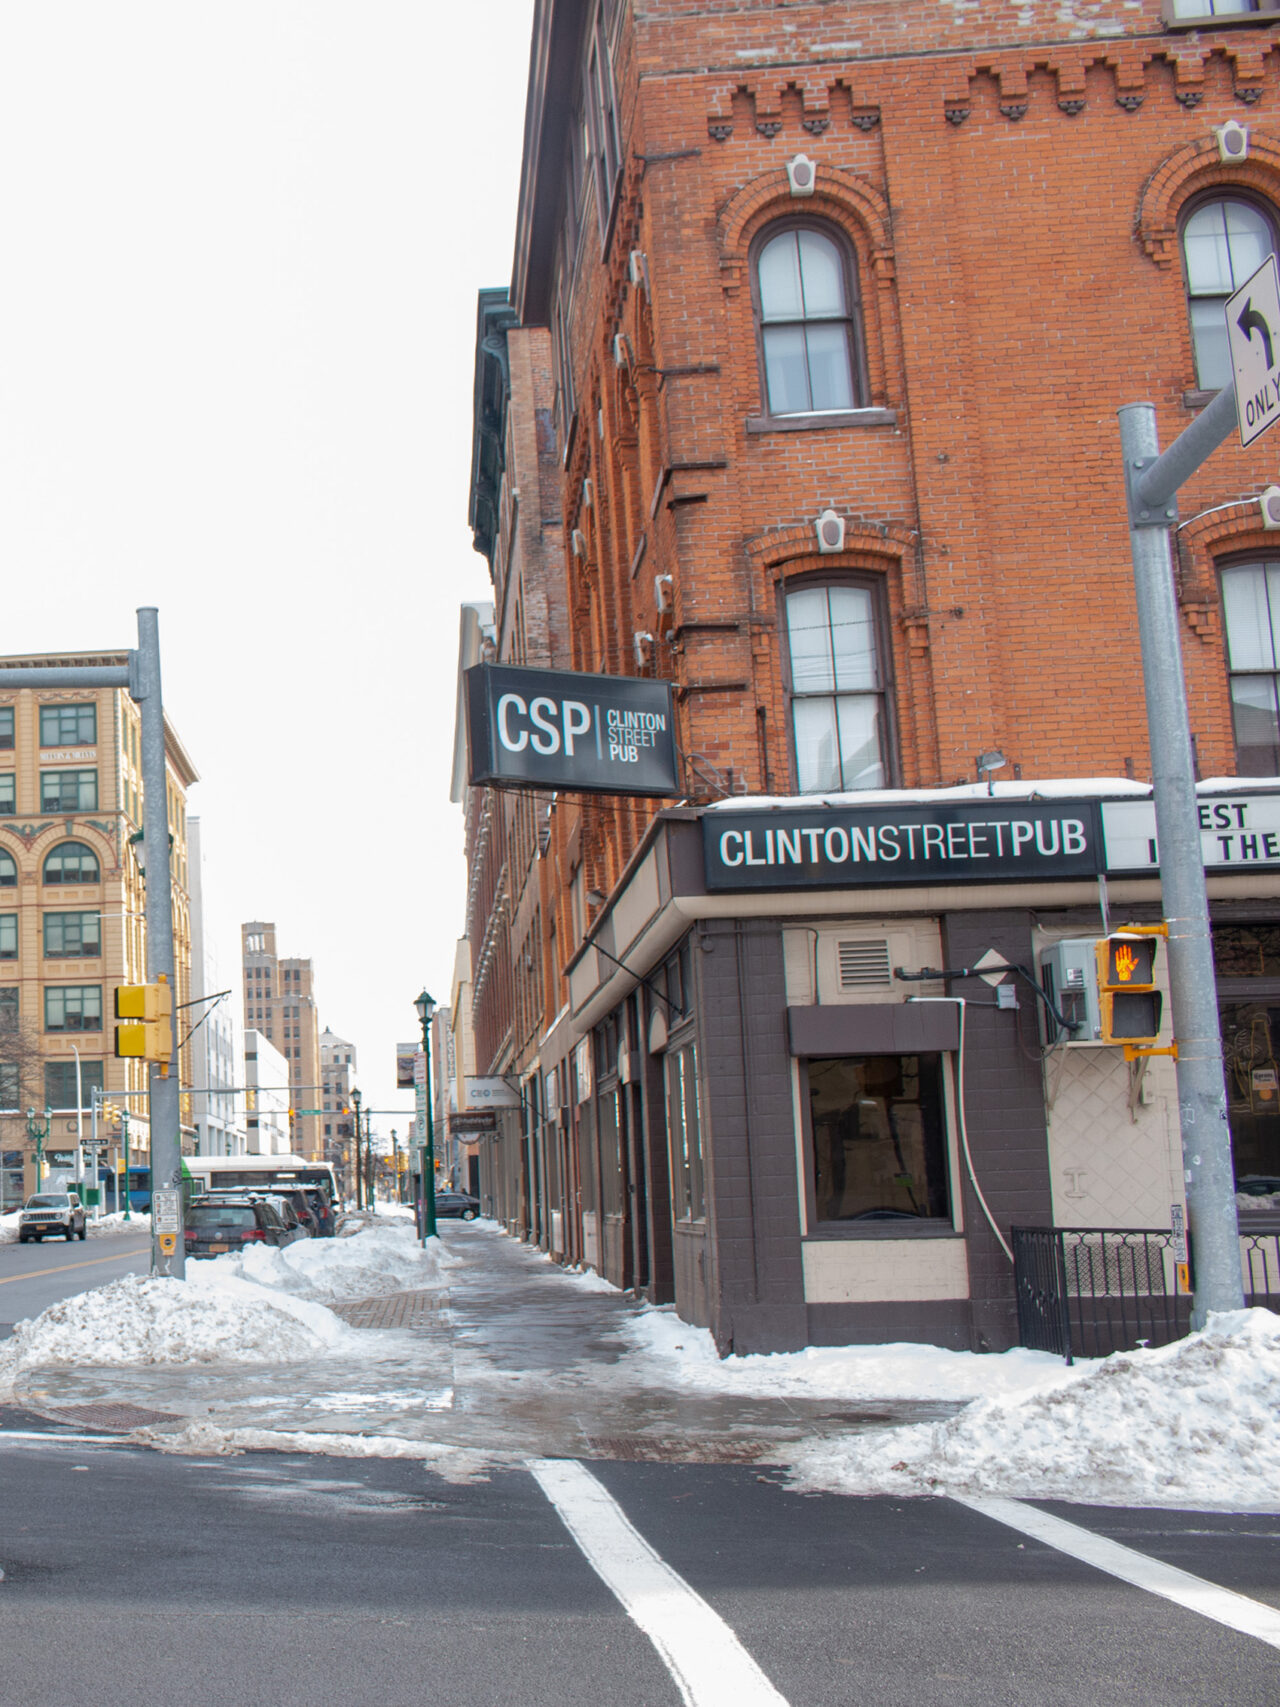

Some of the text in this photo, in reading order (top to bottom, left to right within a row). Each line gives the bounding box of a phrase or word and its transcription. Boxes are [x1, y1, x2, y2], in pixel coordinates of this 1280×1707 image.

[1246, 372, 1280, 426] ONLY
[497, 693, 591, 757] CSP
[607, 709, 666, 732] CLINTON
[608, 726, 657, 747] STREET
[609, 744, 639, 763] PUB
[1197, 804, 1247, 830] EST
[720, 818, 1087, 867] CLINTONSTREETPUB
[1217, 833, 1280, 861] THE
